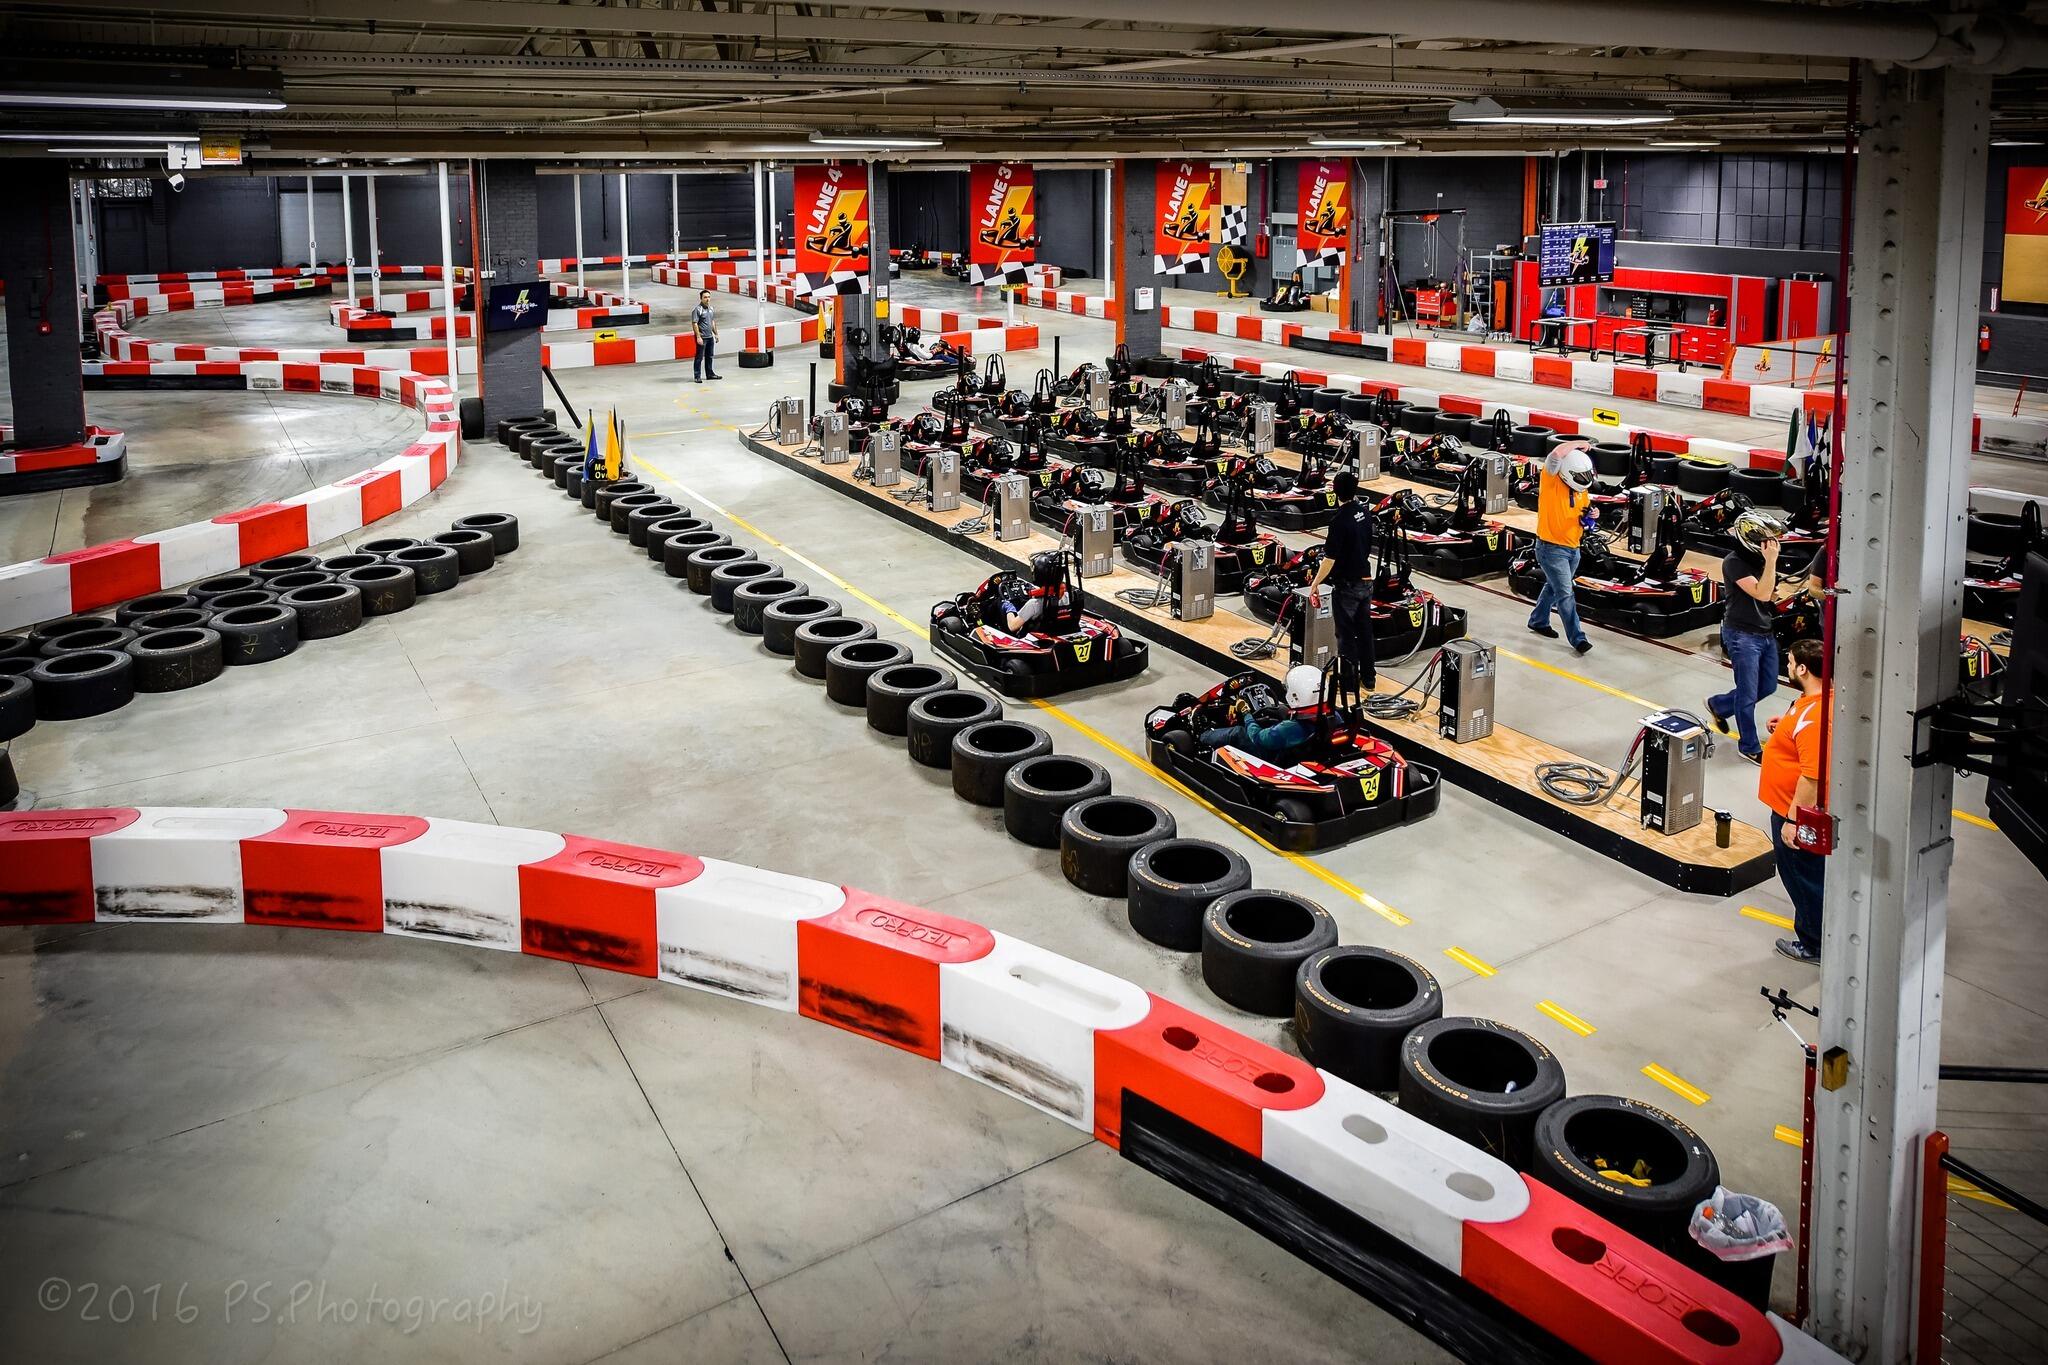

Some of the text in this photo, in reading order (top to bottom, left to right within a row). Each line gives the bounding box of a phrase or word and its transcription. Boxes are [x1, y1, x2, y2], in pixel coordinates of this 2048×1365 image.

[806, 167, 843, 234] LANE 4
[980, 165, 1013, 228] LANE 3
[1164, 163, 1192, 222] LANE 2
[1305, 166, 1330, 219] LANE 1
[310, 241, 316, 249] 8
[348, 258, 354, 266] 7
[624, 259, 629, 267] 5
[373, 269, 379, 278] 6
[1489, 537, 1497, 547] 10
[1255, 550, 1264, 561] 18
[1693, 585, 1702, 598] 11
[1412, 611, 1422, 622] 30
[1077, 643, 1090, 658] 27
[1273, 772, 1291, 782] 24
[1365, 778, 1377, 795] 24
[12, 816, 98, 832] TECPRO
[313, 822, 392, 839] TECPRO
[588, 854, 667, 878] TECPRO
[870, 913, 954, 949] TECPRO
[1412, 1060, 1469, 1101] CONTINENTAL
[1552, 1150, 1624, 1196] CONTINENTAL
